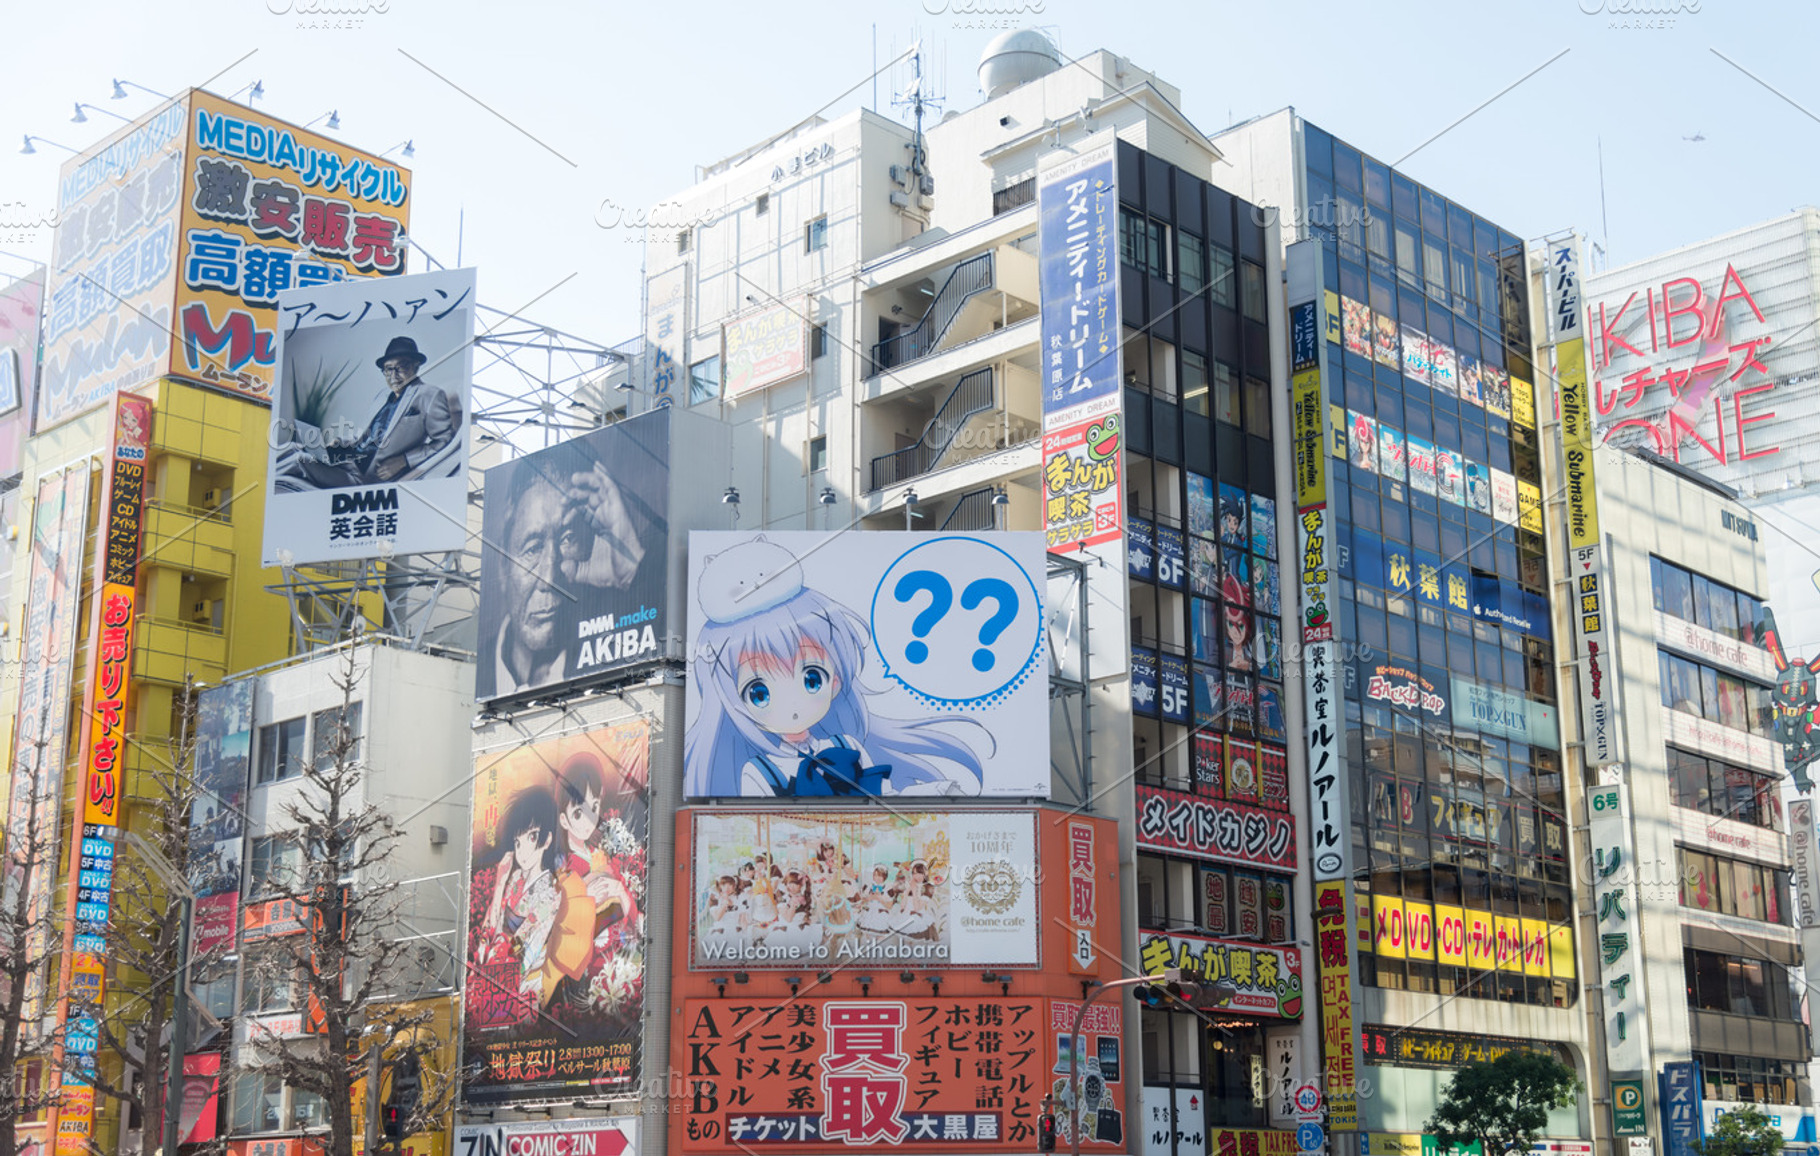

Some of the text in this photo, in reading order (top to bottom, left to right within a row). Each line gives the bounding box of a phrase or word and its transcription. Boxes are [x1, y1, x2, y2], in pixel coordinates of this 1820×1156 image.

[197, 109, 405, 205] MEDIAリサイクル
[1043, 148, 1110, 183] AMENITY DREAM
[196, 160, 402, 270] 激安販売
[49, 224, 174, 342] 高額買取
[1065, 179, 1093, 395] アメニティードリーム
[1554, 247, 1578, 331] スーパービル
[1050, 334, 1064, 401] 秋葉原店
[1049, 398, 1117, 426] AMENITY DREAM
[1303, 390, 1316, 430] Yellow
[117, 462, 141, 476] DVD
[1046, 452, 1117, 492] まんが
[1562, 383, 1586, 537] Yellow Submarine
[114, 489, 140, 504] ゲーム
[117, 504, 134, 516] CD
[330, 488, 399, 515] DMM
[1047, 490, 1091, 523] 喫茶
[109, 529, 137, 543] アニメ
[111, 516, 138, 530] アイドル
[329, 513, 398, 541] 英会話
[1098, 514, 1115, 529] 3F
[109, 543, 135, 557] コミック
[1302, 508, 1325, 570] まんが
[1158, 553, 1185, 583] 6F
[1577, 548, 1594, 561] 5F
[1303, 570, 1329, 585] 喫茶
[1388, 553, 1469, 611] 秋葉館
[1579, 573, 1601, 634] 秋葉館
[578, 605, 657, 639] DMM.make
[577, 624, 657, 670] AKIBA
[1684, 626, 1748, 667] @home cafe
[1162, 683, 1189, 715] 5F
[1367, 675, 1445, 715] BACKDROP
[1196, 770, 1221, 785] Stars
[1592, 792, 1618, 811] 6号
[1140, 795, 1291, 862] メイドカジノ
[84, 844, 112, 856] DVD
[971, 841, 1014, 854] 10周年
[81, 857, 112, 871] 5F 中古
[1068, 823, 1096, 927] 買取
[1794, 830, 1816, 925] @home cafe
[78, 889, 92, 901] 4F
[81, 876, 109, 888] DVD
[78, 908, 107, 920] DVD
[960, 915, 1026, 928] @home cafe
[1318, 888, 1348, 969] 免税
[701, 938, 949, 962] Welcome to Akihabara
[1079, 932, 1091, 960] 入口
[1594, 846, 1630, 1041] リバティー
[1286, 952, 1301, 969] 3F
[1336, 974, 1350, 1020] TAX
[726, 1006, 754, 1107] アイドル
[757, 1006, 785, 1080] アニメ
[944, 1004, 971, 1079] ホビー
[974, 1004, 1004, 1109] 携帯電話
[489, 1050, 556, 1081] 地獄祭り
[786, 1004, 817, 1110] 美少女系
[913, 1005, 942, 1110] フィギュア
[1340, 1027, 1355, 1087] FREE
[820, 1002, 910, 1145] 買取
[1007, 1004, 1036, 1142] アップルとか
[60, 1104, 91, 1117] ムーラン
[1300, 1092, 1316, 1105] 40
[1625, 1090, 1636, 1105] P
[1669, 1069, 1693, 1137] ドスパラ
[59, 1121, 90, 1133] AKIBA
[460, 1127, 479, 1135] COMIC
[460, 1128, 504, 1156] ZIN
[727, 1115, 817, 1142] チケット
[913, 1114, 999, 1140] 大黒屋
[1264, 1131, 1284, 1153] TAX
[1635, 1124, 1645, 1133] IN
[508, 1133, 597, 1156] COMIC ZIN
[1217, 1130, 1261, 1156] 免税
